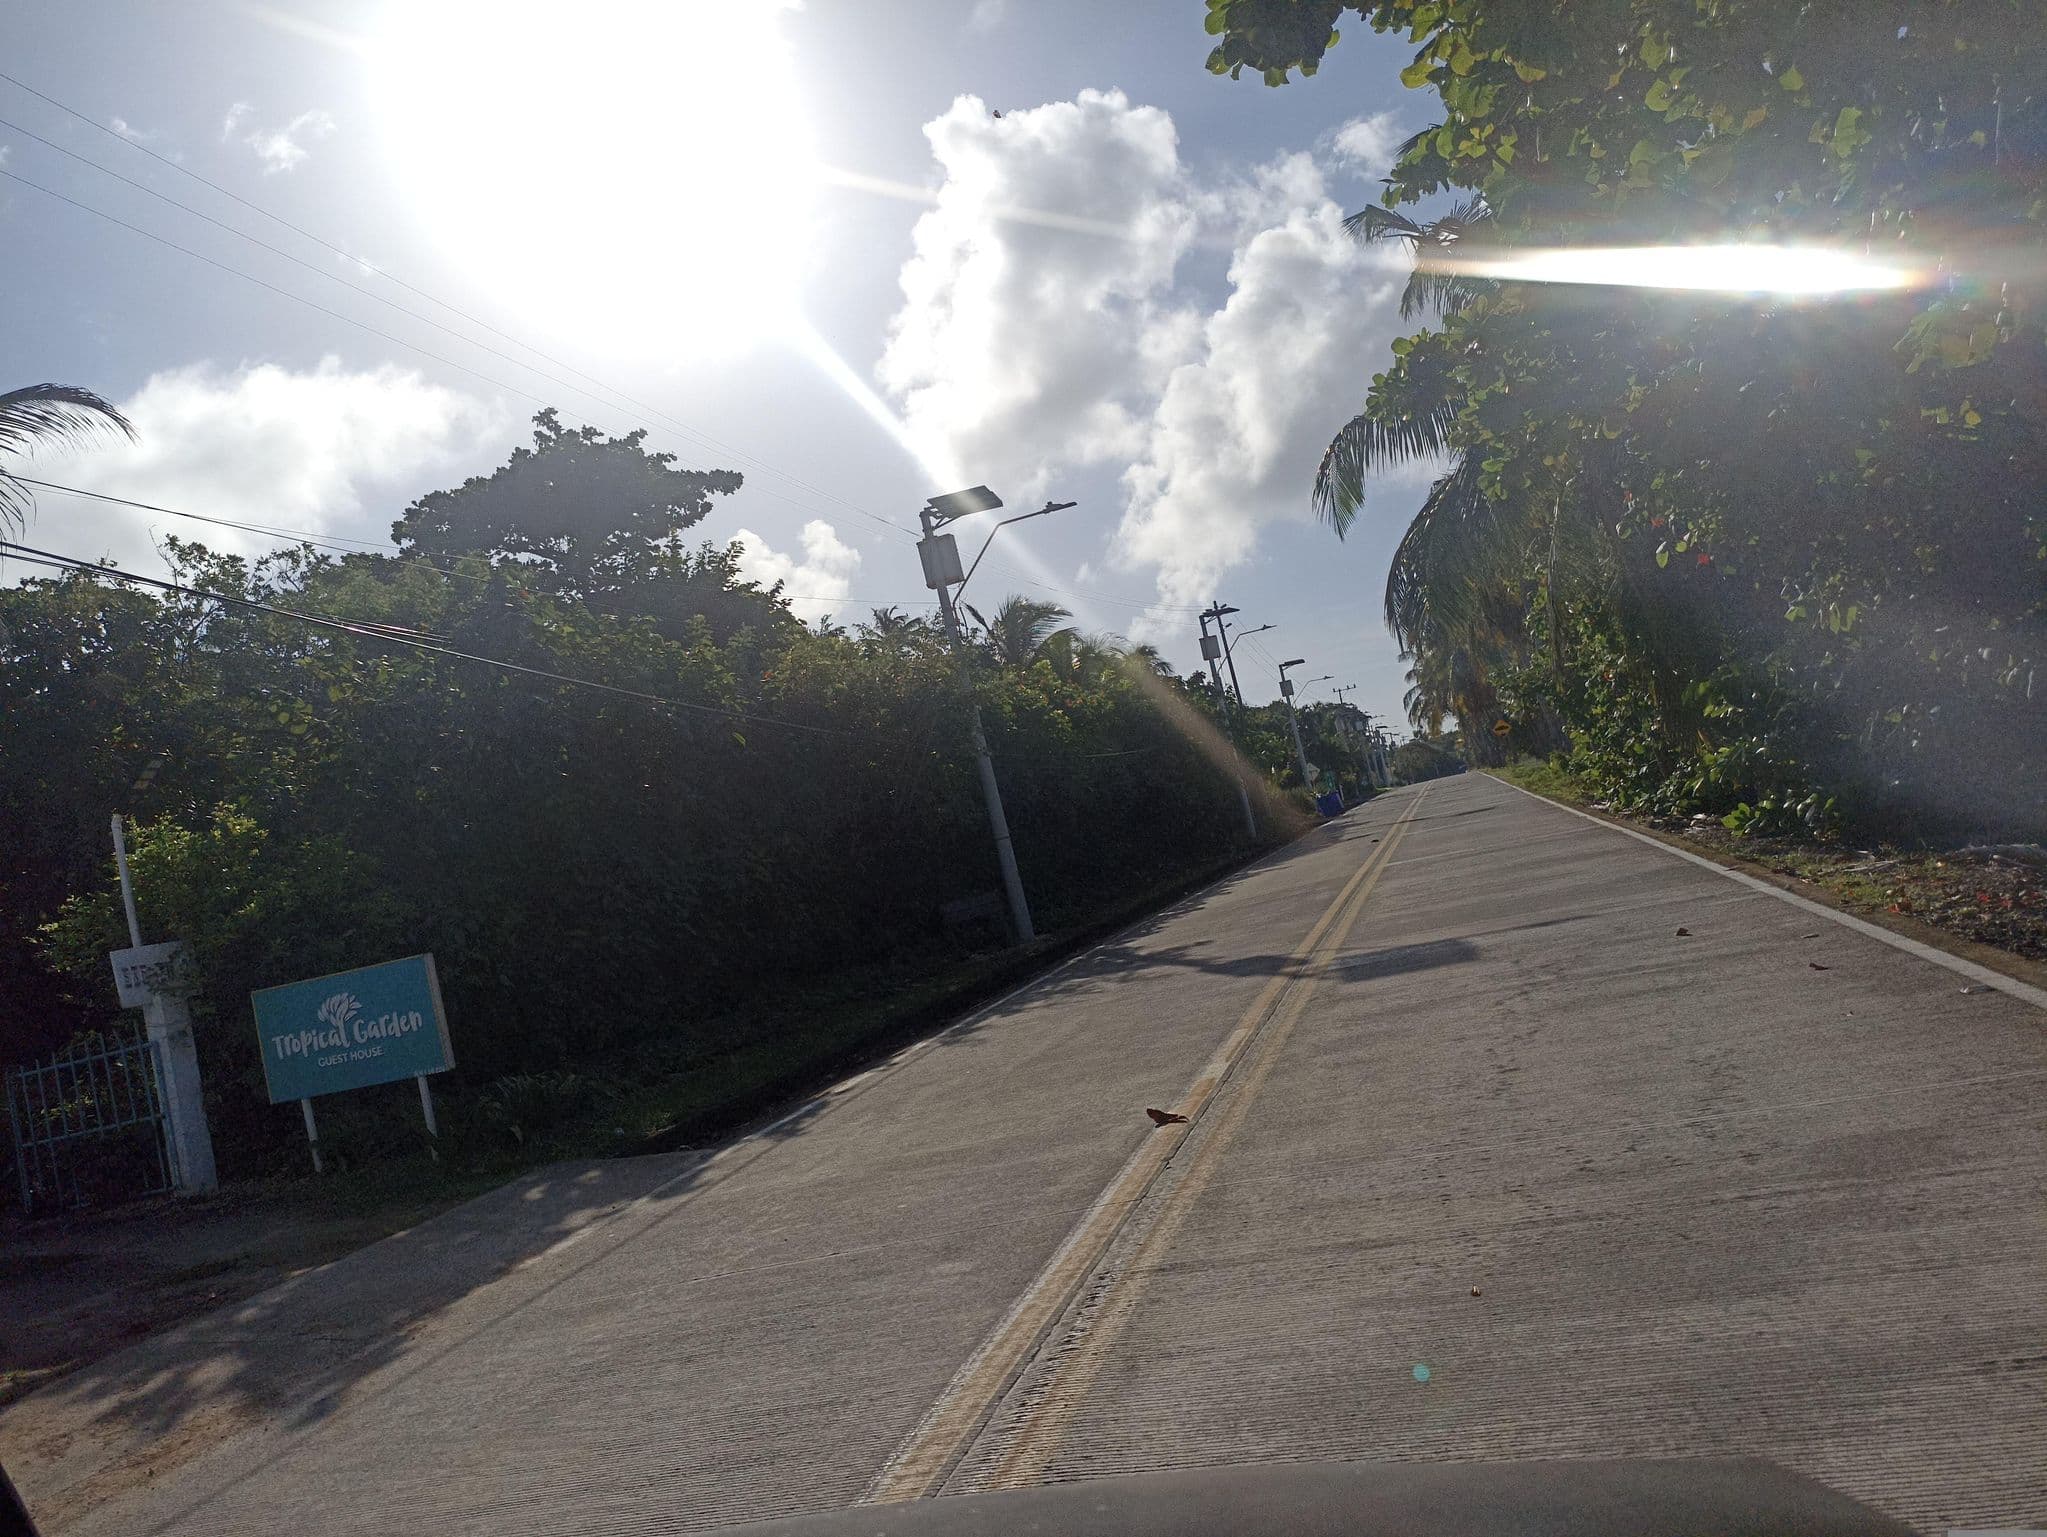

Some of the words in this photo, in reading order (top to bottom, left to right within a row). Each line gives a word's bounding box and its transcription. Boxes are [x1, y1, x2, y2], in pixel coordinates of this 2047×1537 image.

[272, 1023, 350, 1060] Tropical
[353, 1011, 423, 1044] Garden
[318, 1054, 348, 1068] GUEST
[351, 1046, 384, 1061] HOUSE
